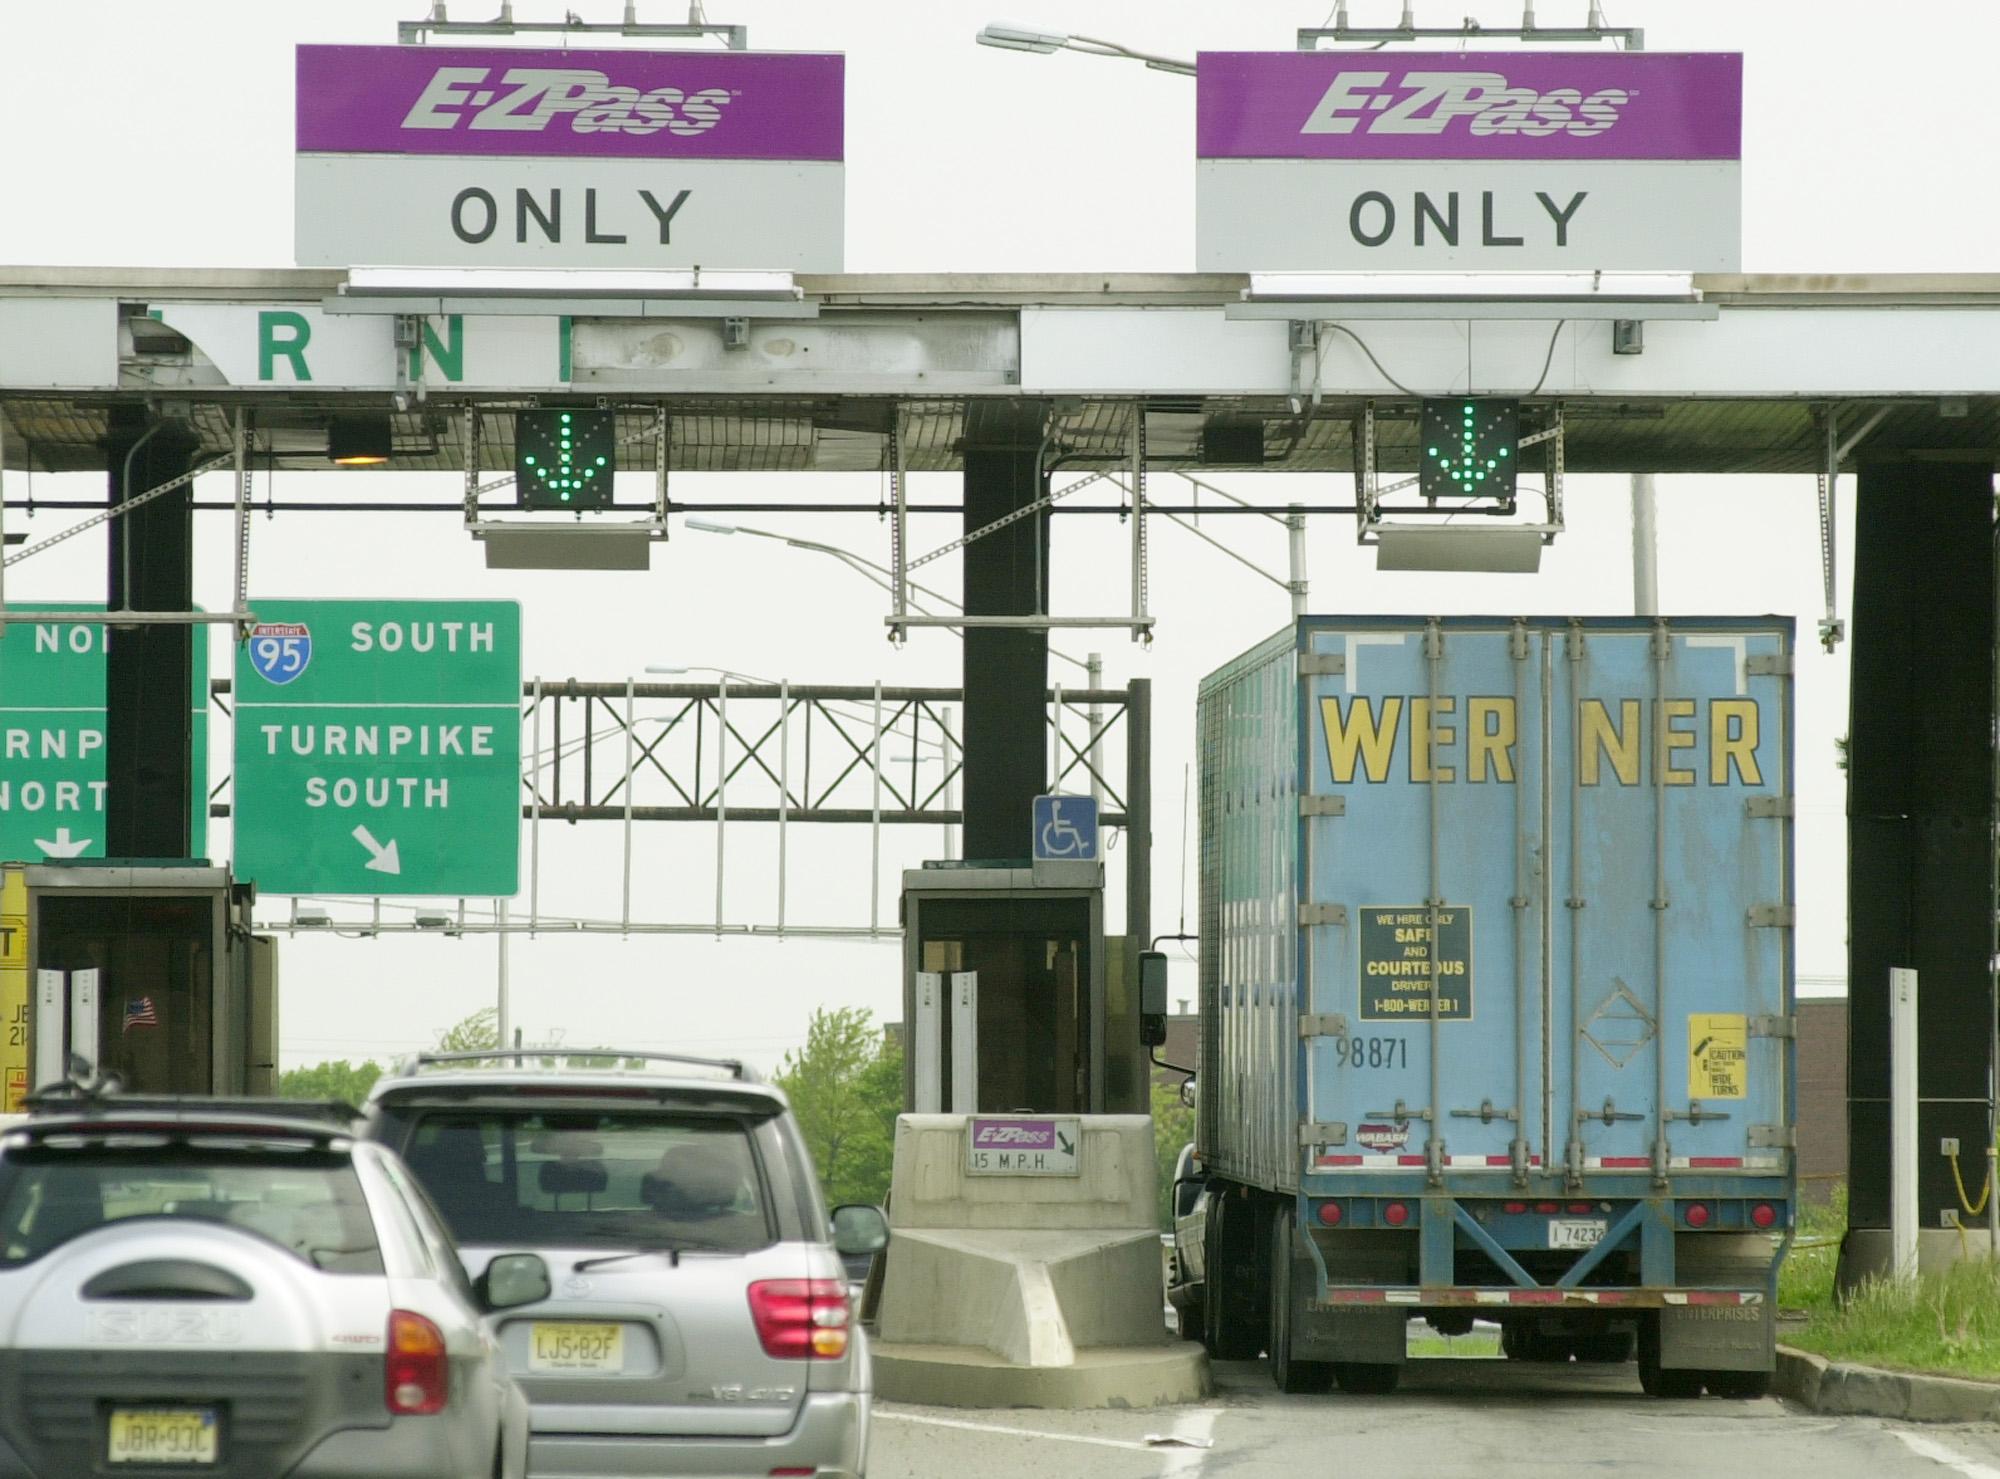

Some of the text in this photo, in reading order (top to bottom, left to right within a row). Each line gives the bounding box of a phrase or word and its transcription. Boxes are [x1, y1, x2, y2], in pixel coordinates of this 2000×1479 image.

[401, 67, 730, 135] E-ZPass
[1300, 71, 1629, 137] E-ZPass
[451, 187, 693, 245] ONLY
[1349, 191, 1588, 247] ONLY
[351, 621, 494, 652] SOUTH
[257, 639, 301, 672] 95
[261, 725, 494, 756] TURNPIKE
[1318, 696, 1765, 786] WERNER
[305, 777, 448, 808] SOUTH
[1376, 914, 1394, 925] WE
[1404, 946, 1427, 957] AND
[1336, 1037, 1406, 1069] 98871
[974, 1153, 988, 1168] 15
